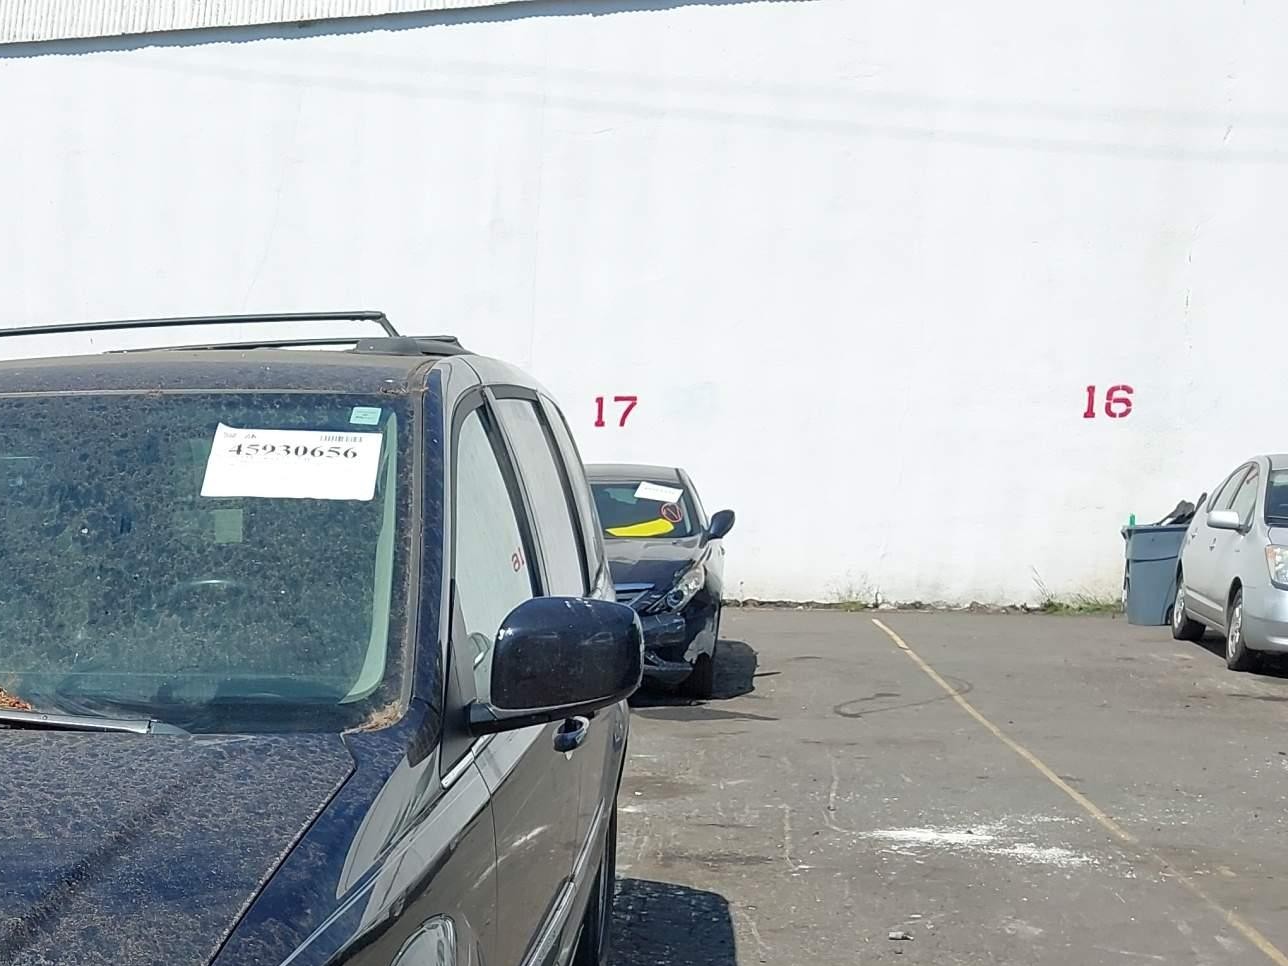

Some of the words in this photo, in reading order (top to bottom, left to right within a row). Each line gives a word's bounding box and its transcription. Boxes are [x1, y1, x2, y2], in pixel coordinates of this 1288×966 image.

[594, 395, 638, 427] 17
[1083, 384, 1134, 419] 16
[229, 443, 358, 459] 45930656
